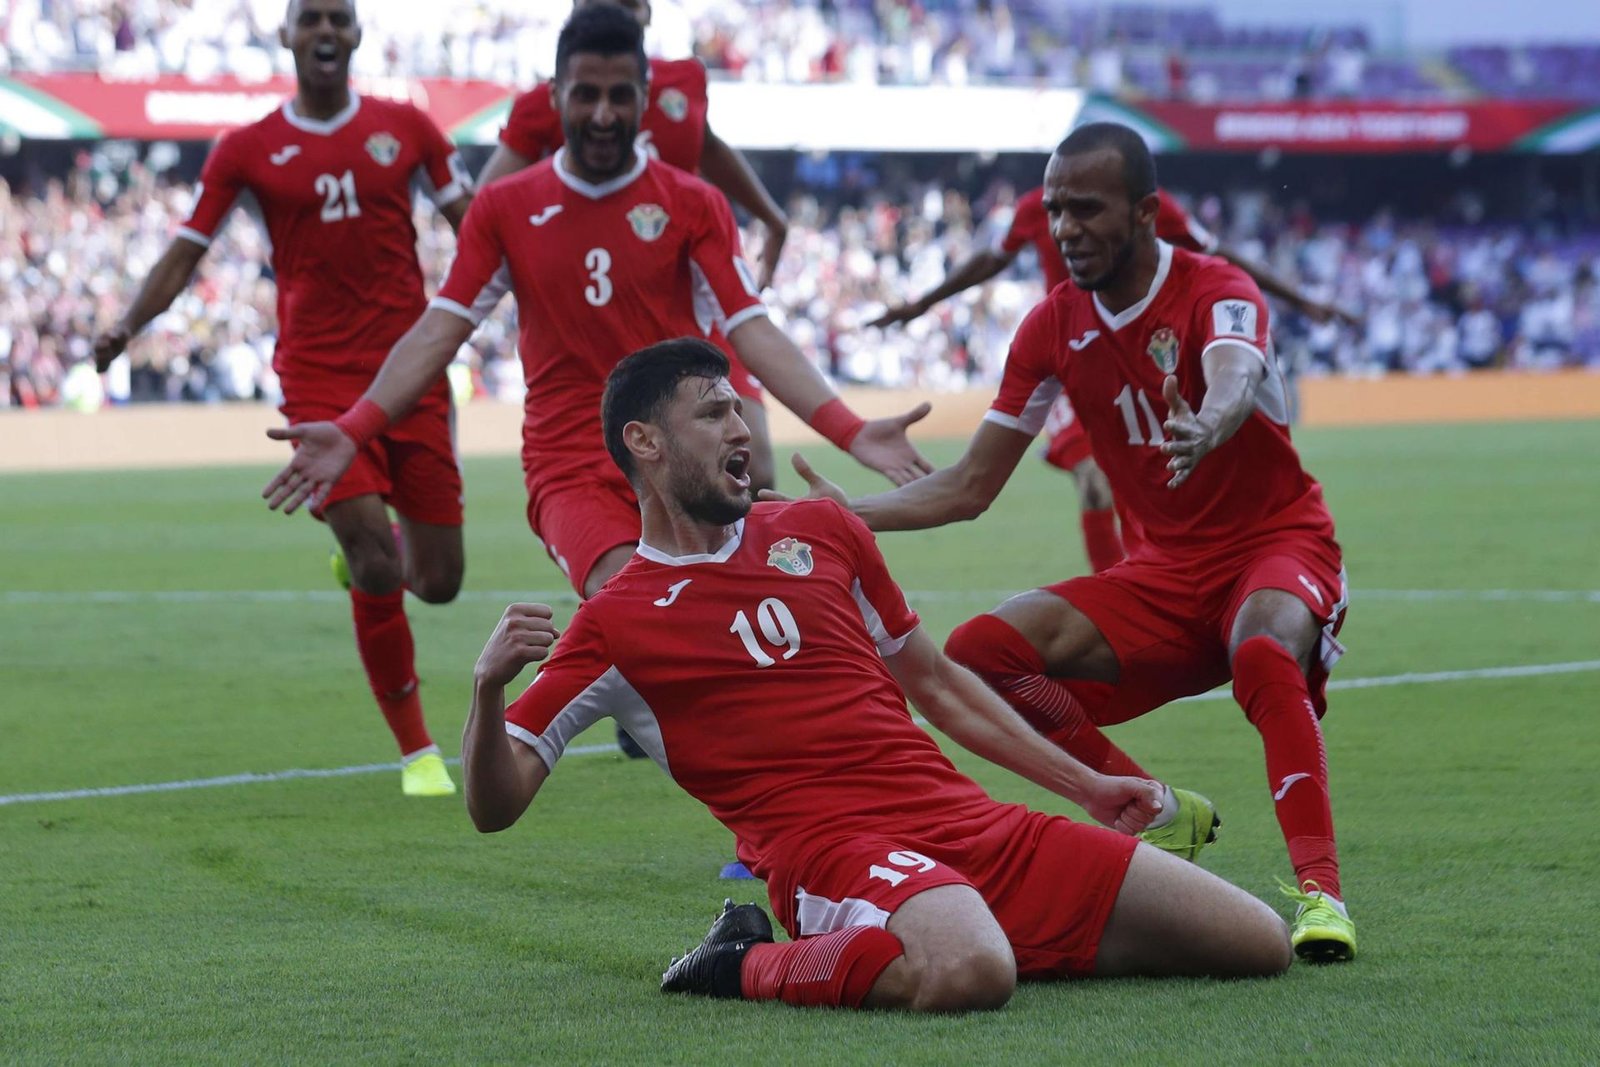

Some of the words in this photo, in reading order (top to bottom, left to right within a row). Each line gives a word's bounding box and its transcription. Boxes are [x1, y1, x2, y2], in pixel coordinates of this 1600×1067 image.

[314, 169, 361, 223] 21
[584, 247, 613, 307] 3
[1113, 384, 1165, 445] 11
[729, 597, 801, 669] 19
[869, 851, 937, 887] 19
